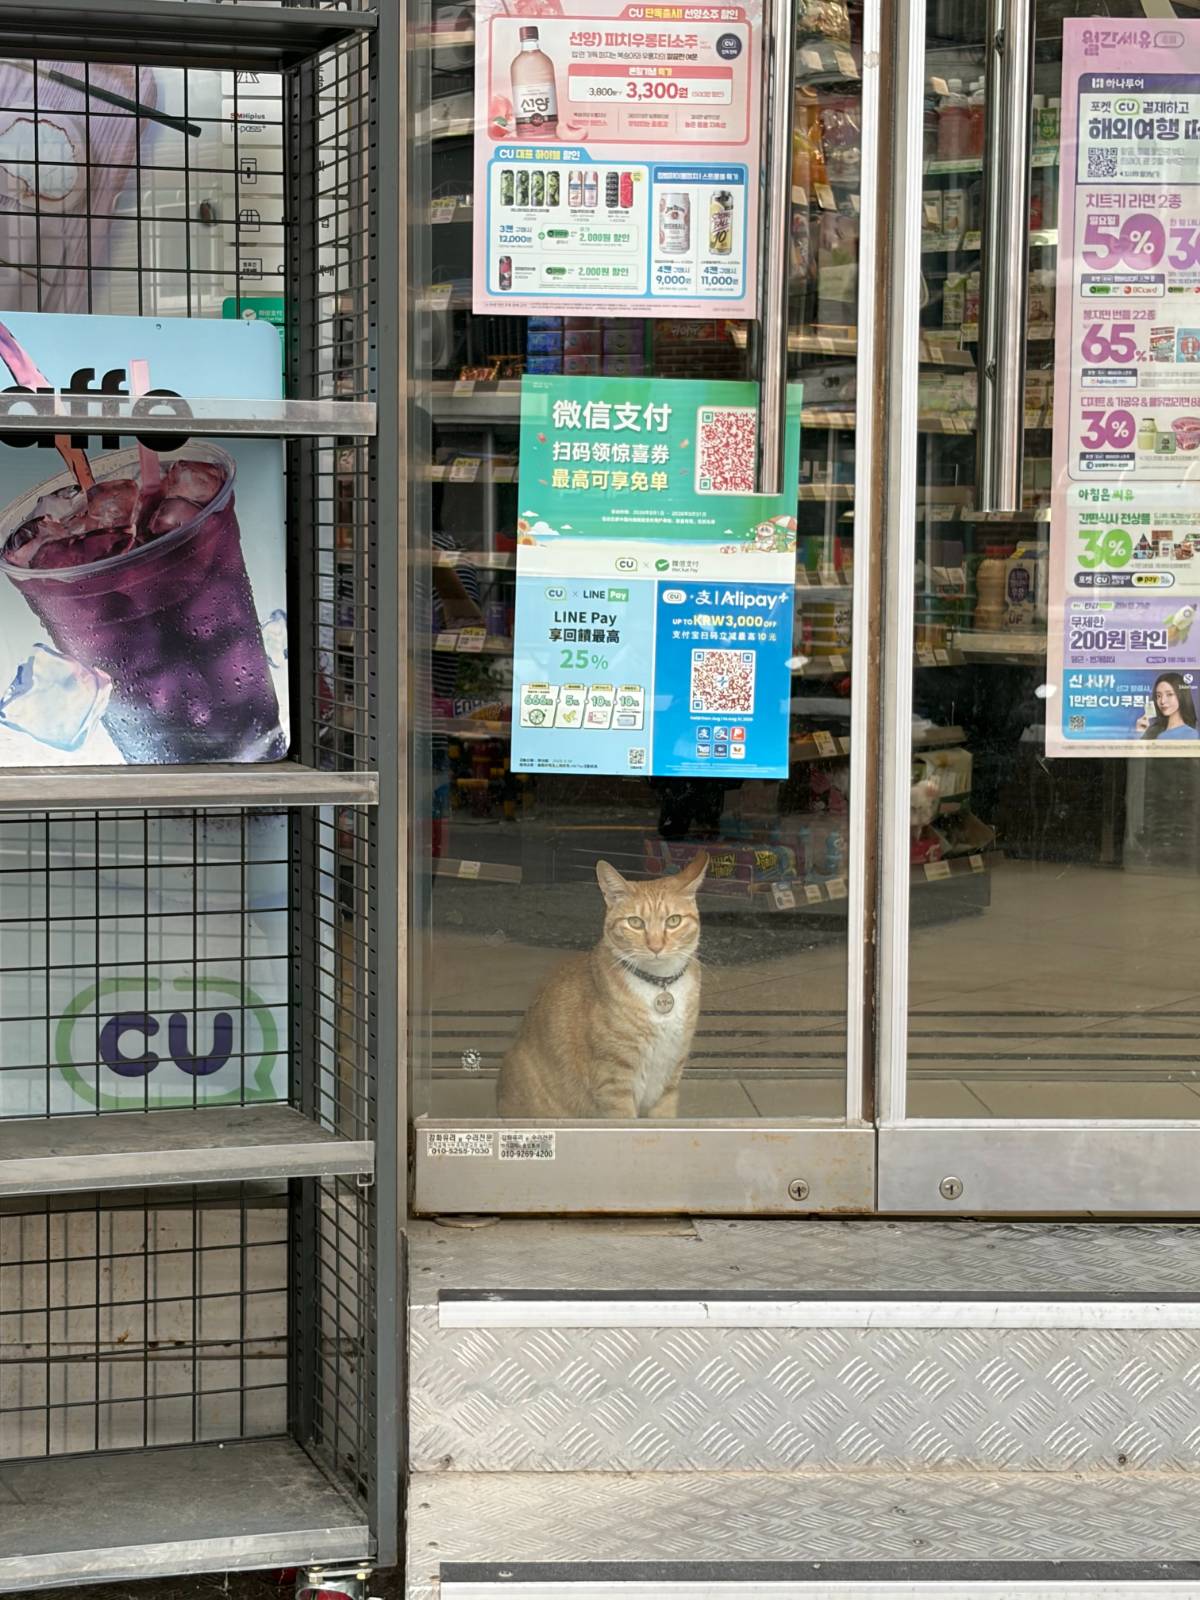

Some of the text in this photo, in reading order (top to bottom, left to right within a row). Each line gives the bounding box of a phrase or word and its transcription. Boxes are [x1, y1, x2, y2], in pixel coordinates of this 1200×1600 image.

[629, 8, 643, 17] CU
[685, 9, 719, 19] 선양소주
[721, 10, 738, 20] 할인
[605, 33, 698, 49] 피치우롱티소주
[1106, 79, 1144, 88] 하나투어
[626, 82, 688, 101] 3,300원
[521, 97, 550, 113] 선양
[1090, 102, 1189, 114] 포켓 CU 결제하고
[1089, 118, 1180, 141] 해외여행
[500, 150, 514, 159] CU
[563, 151, 580, 161] 할인
[1086, 193, 1182, 209] 치트키 라면 2종
[613, 233, 630, 243] 할인
[1167, 228, 1200, 270] 3
[612, 267, 629, 277] 할인
[1132, 310, 1155, 320] 22종
[1081, 323, 1147, 364] 65%
[552, 400, 672, 432] 微信支付
[1080, 409, 1136, 449] 30%
[552, 441, 670, 465] 扫码领惊喜券
[552, 469, 669, 492] 最高可享免单
[1078, 488, 1110, 501] 아침은
[1079, 513, 1119, 525] 간편식사
[1121, 513, 1150, 525] 전상품
[1077, 528, 1134, 568] 30%
[619, 560, 634, 569] CU
[548, 590, 627, 600] CU LINE Pay
[721, 590, 789, 610] Alipay+
[554, 612, 617, 626] LINE Pay
[1071, 616, 1104, 628] 무제한
[549, 628, 620, 643] 享回饋最高
[1071, 630, 1167, 650] 200원 할인
[559, 649, 608, 670] 25%
[1099, 696, 1119, 707] CU
[100, 1011, 233, 1077] CU
[501, 1150, 553, 1158] 010-9269-4200
